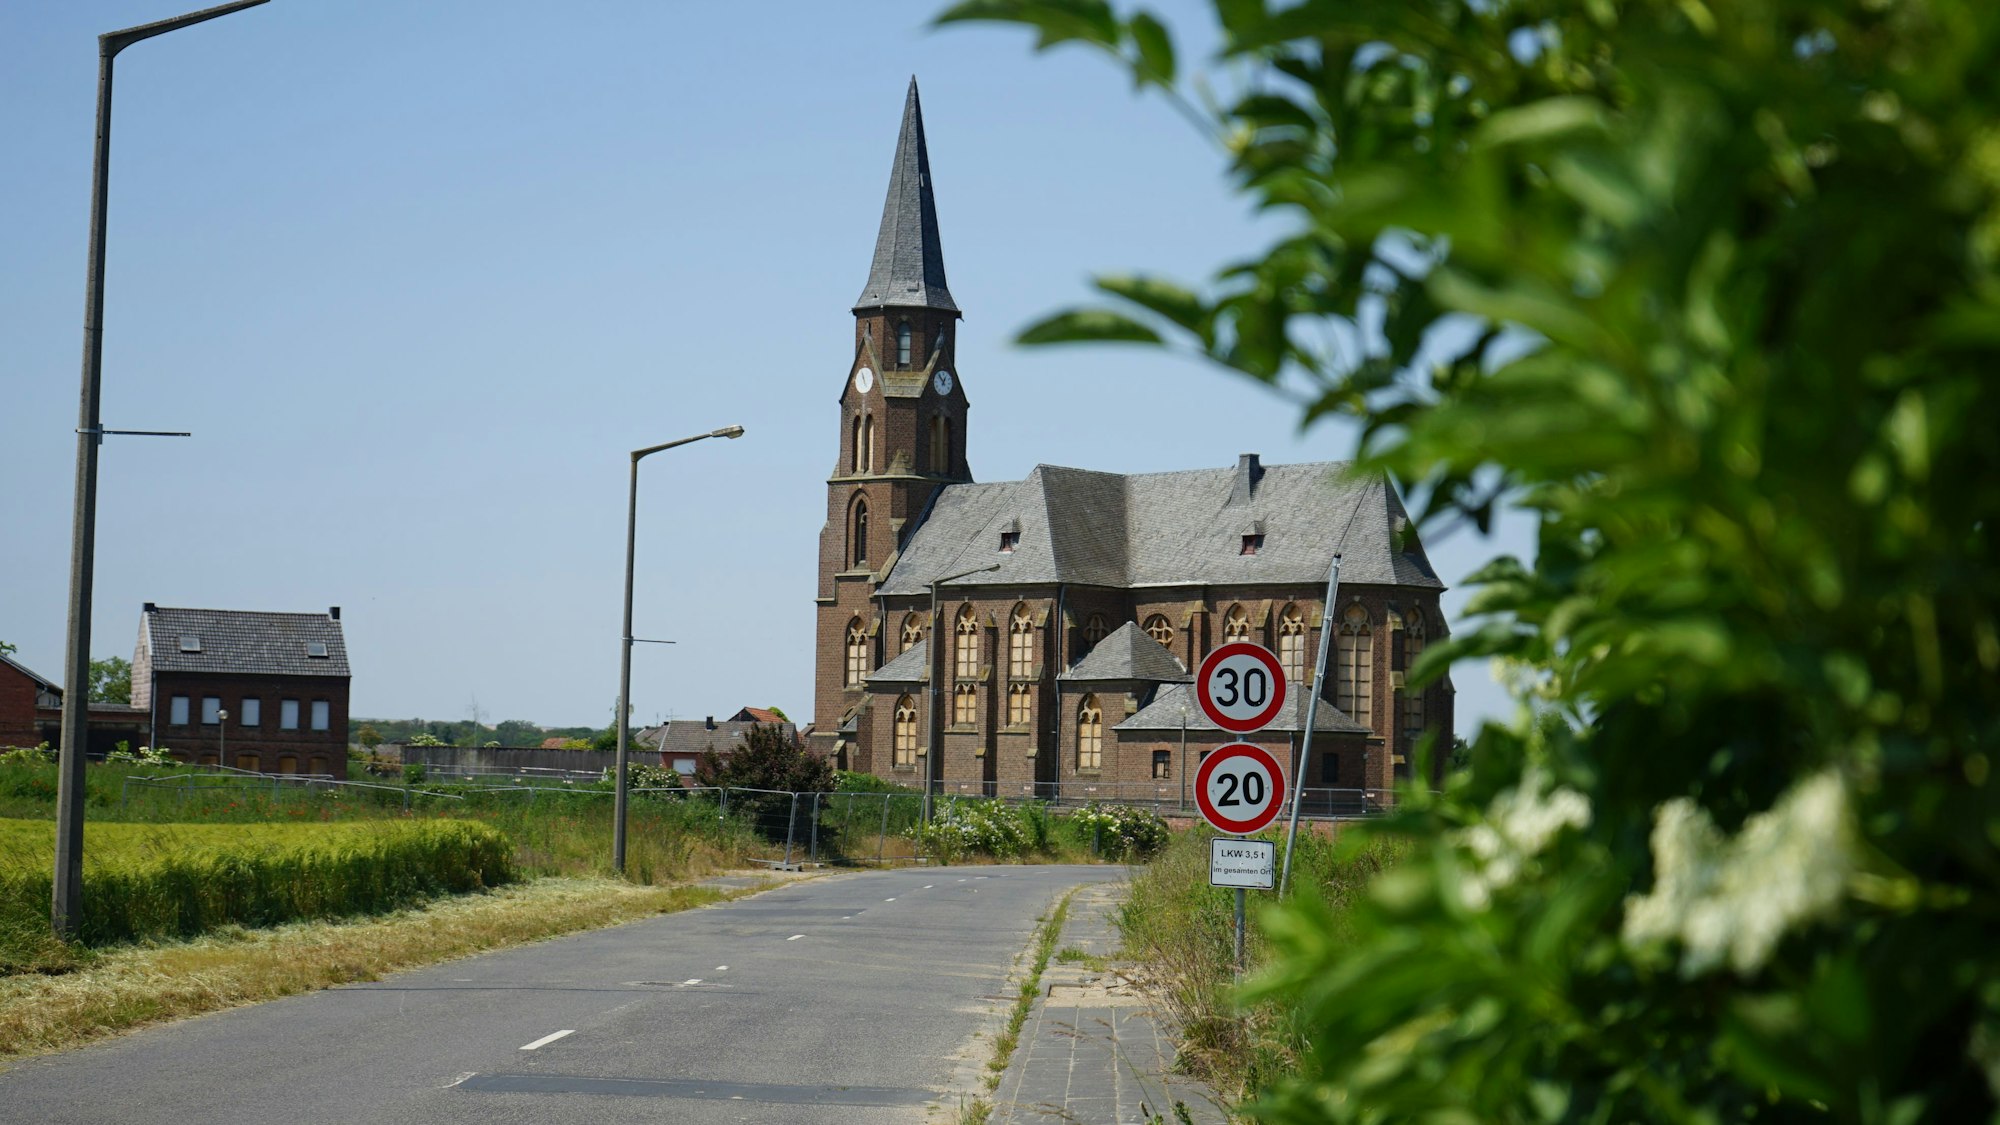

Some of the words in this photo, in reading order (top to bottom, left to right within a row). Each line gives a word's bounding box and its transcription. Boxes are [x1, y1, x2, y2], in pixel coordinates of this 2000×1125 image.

[1216, 668, 1266, 707] 30
[1217, 771, 1264, 807] 20
[1221, 849, 1243, 858] LKW
[1245, 850, 1259, 860] 3,5
